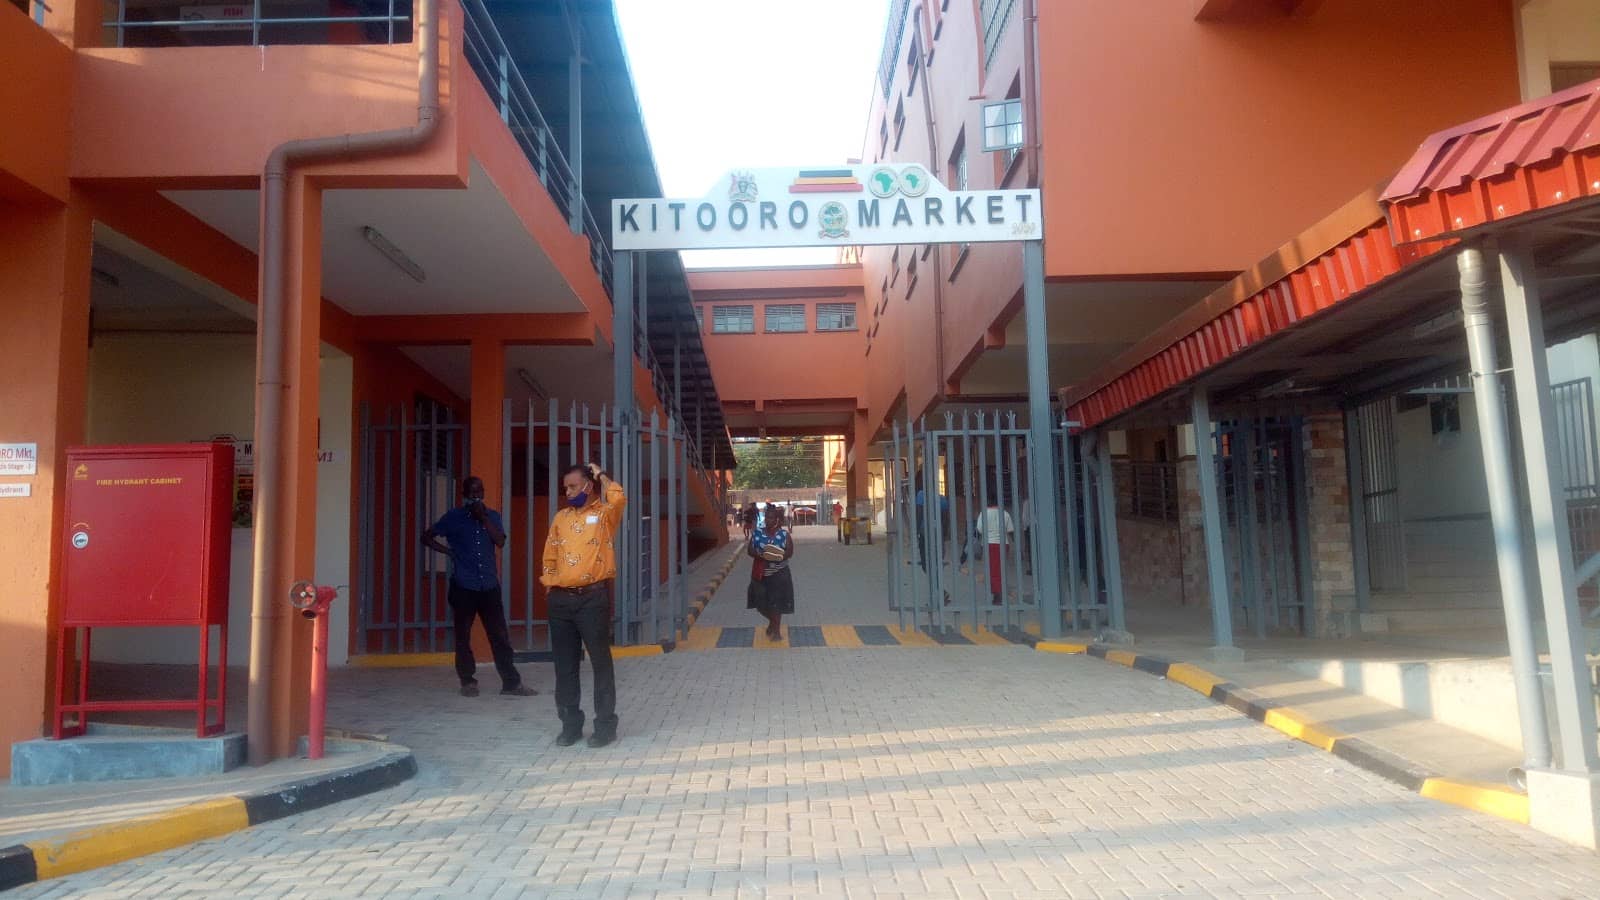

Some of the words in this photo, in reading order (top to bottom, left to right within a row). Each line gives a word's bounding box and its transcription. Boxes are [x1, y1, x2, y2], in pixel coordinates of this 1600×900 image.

[620, 200, 809, 232] KITOORO
[858, 194, 1032, 227] MARKET
[150, 477, 183, 485] CABINET
